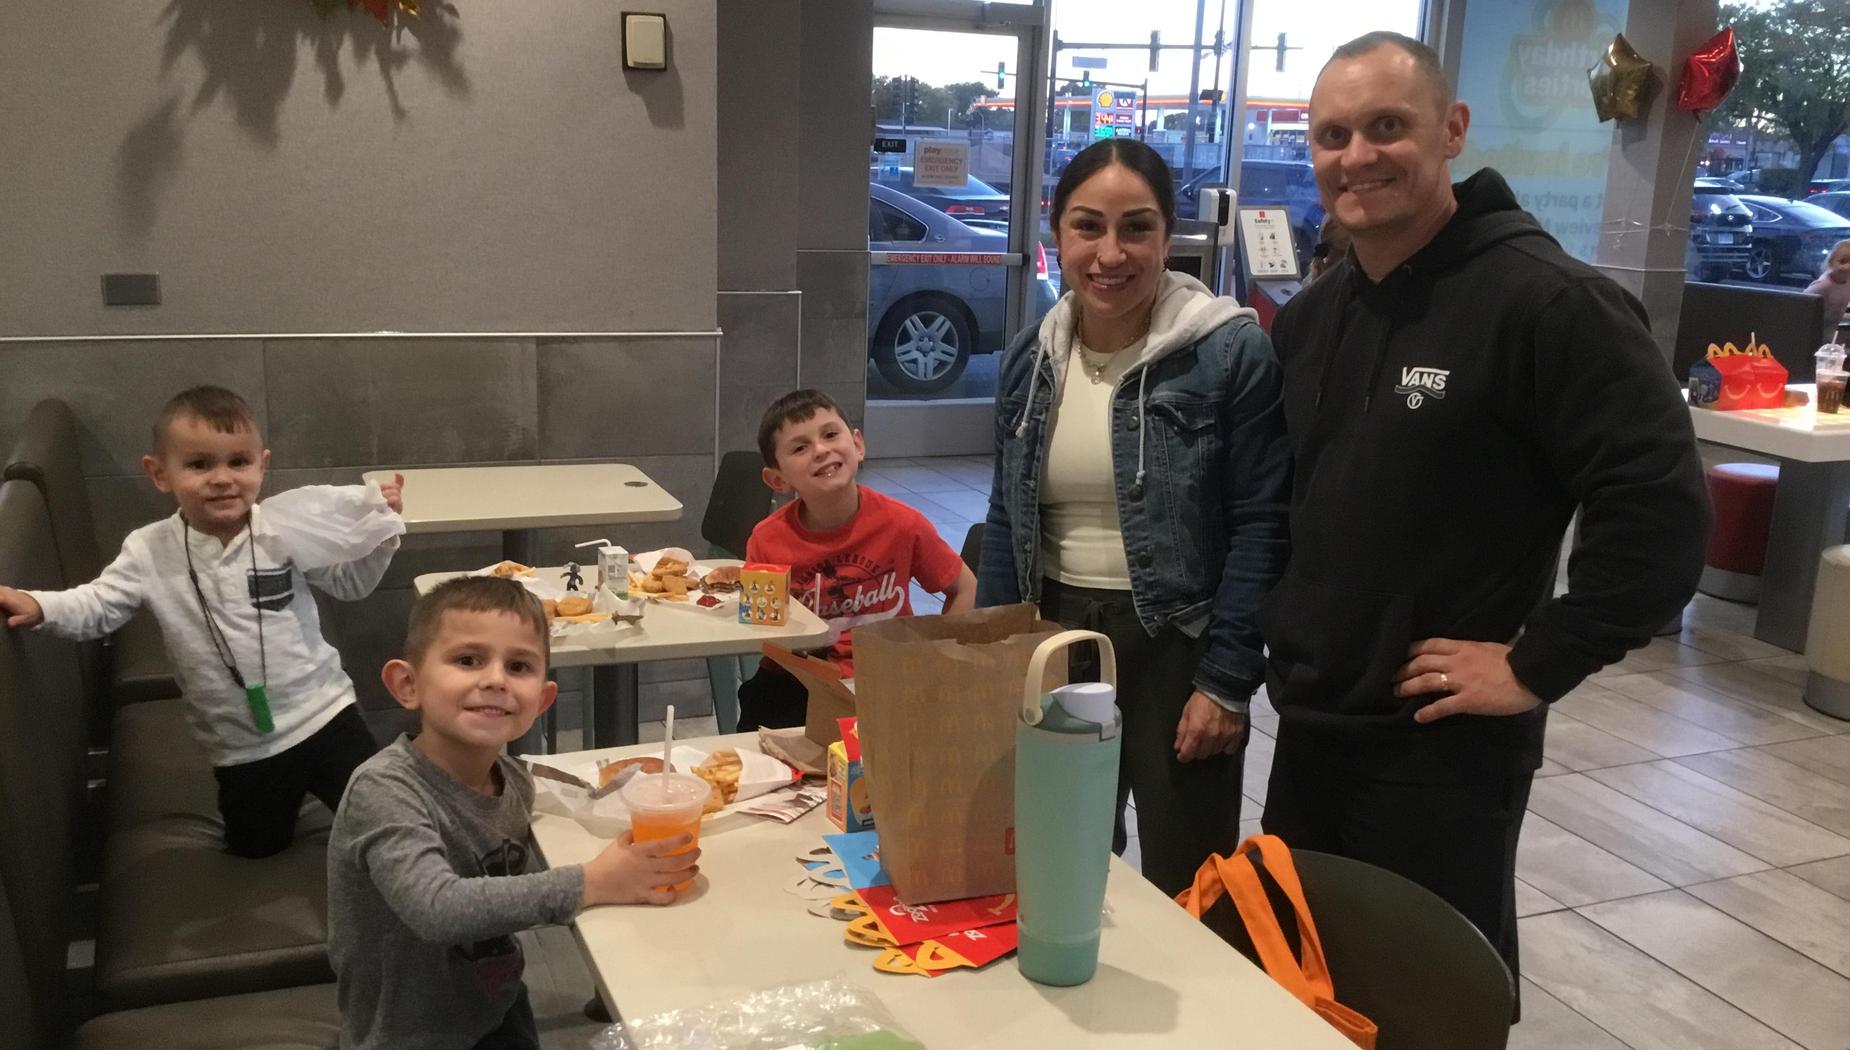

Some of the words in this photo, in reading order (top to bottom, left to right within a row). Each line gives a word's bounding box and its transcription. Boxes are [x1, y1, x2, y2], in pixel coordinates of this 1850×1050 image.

[882, 140, 898, 148] EXIT
[887, 254, 920, 264] EMERGENCY
[921, 255, 933, 264] EXIT
[934, 255, 947, 264] ONLY
[951, 255, 970, 264] ALARM
[970, 255, 983, 264] WILL
[984, 255, 1001, 264] SOUND
[1401, 366, 1450, 390] VANS
